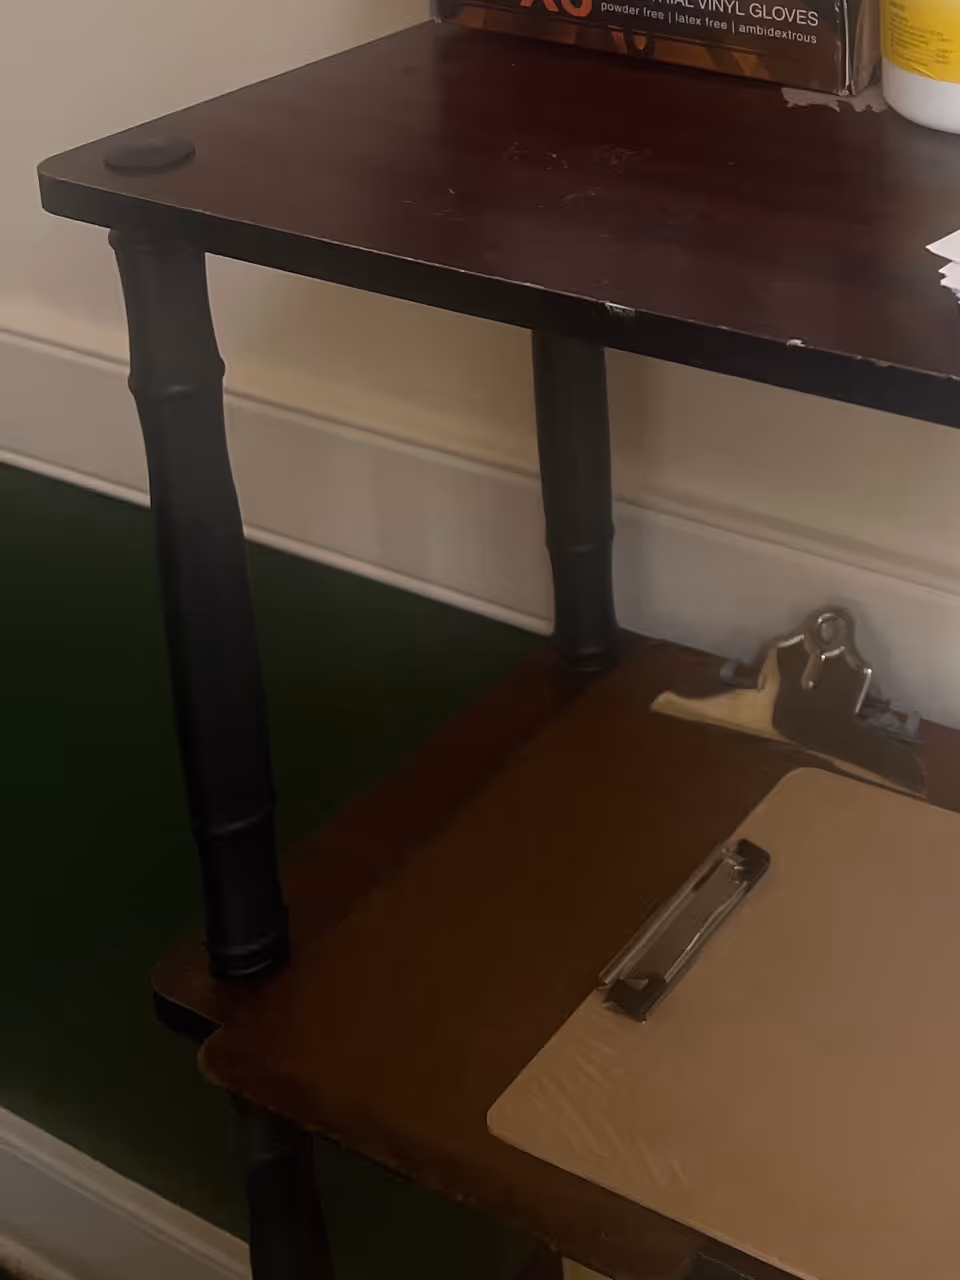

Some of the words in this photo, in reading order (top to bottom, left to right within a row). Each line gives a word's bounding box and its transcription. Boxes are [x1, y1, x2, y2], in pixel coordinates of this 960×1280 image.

[601, 1, 641, 16] powder
[643, 7, 665, 20] free
[675, 11, 702, 26] latex
[705, 16, 728, 30] free
[739, 23, 817, 45] ambidextrous
[749, 2, 819, 27] GLOVES
